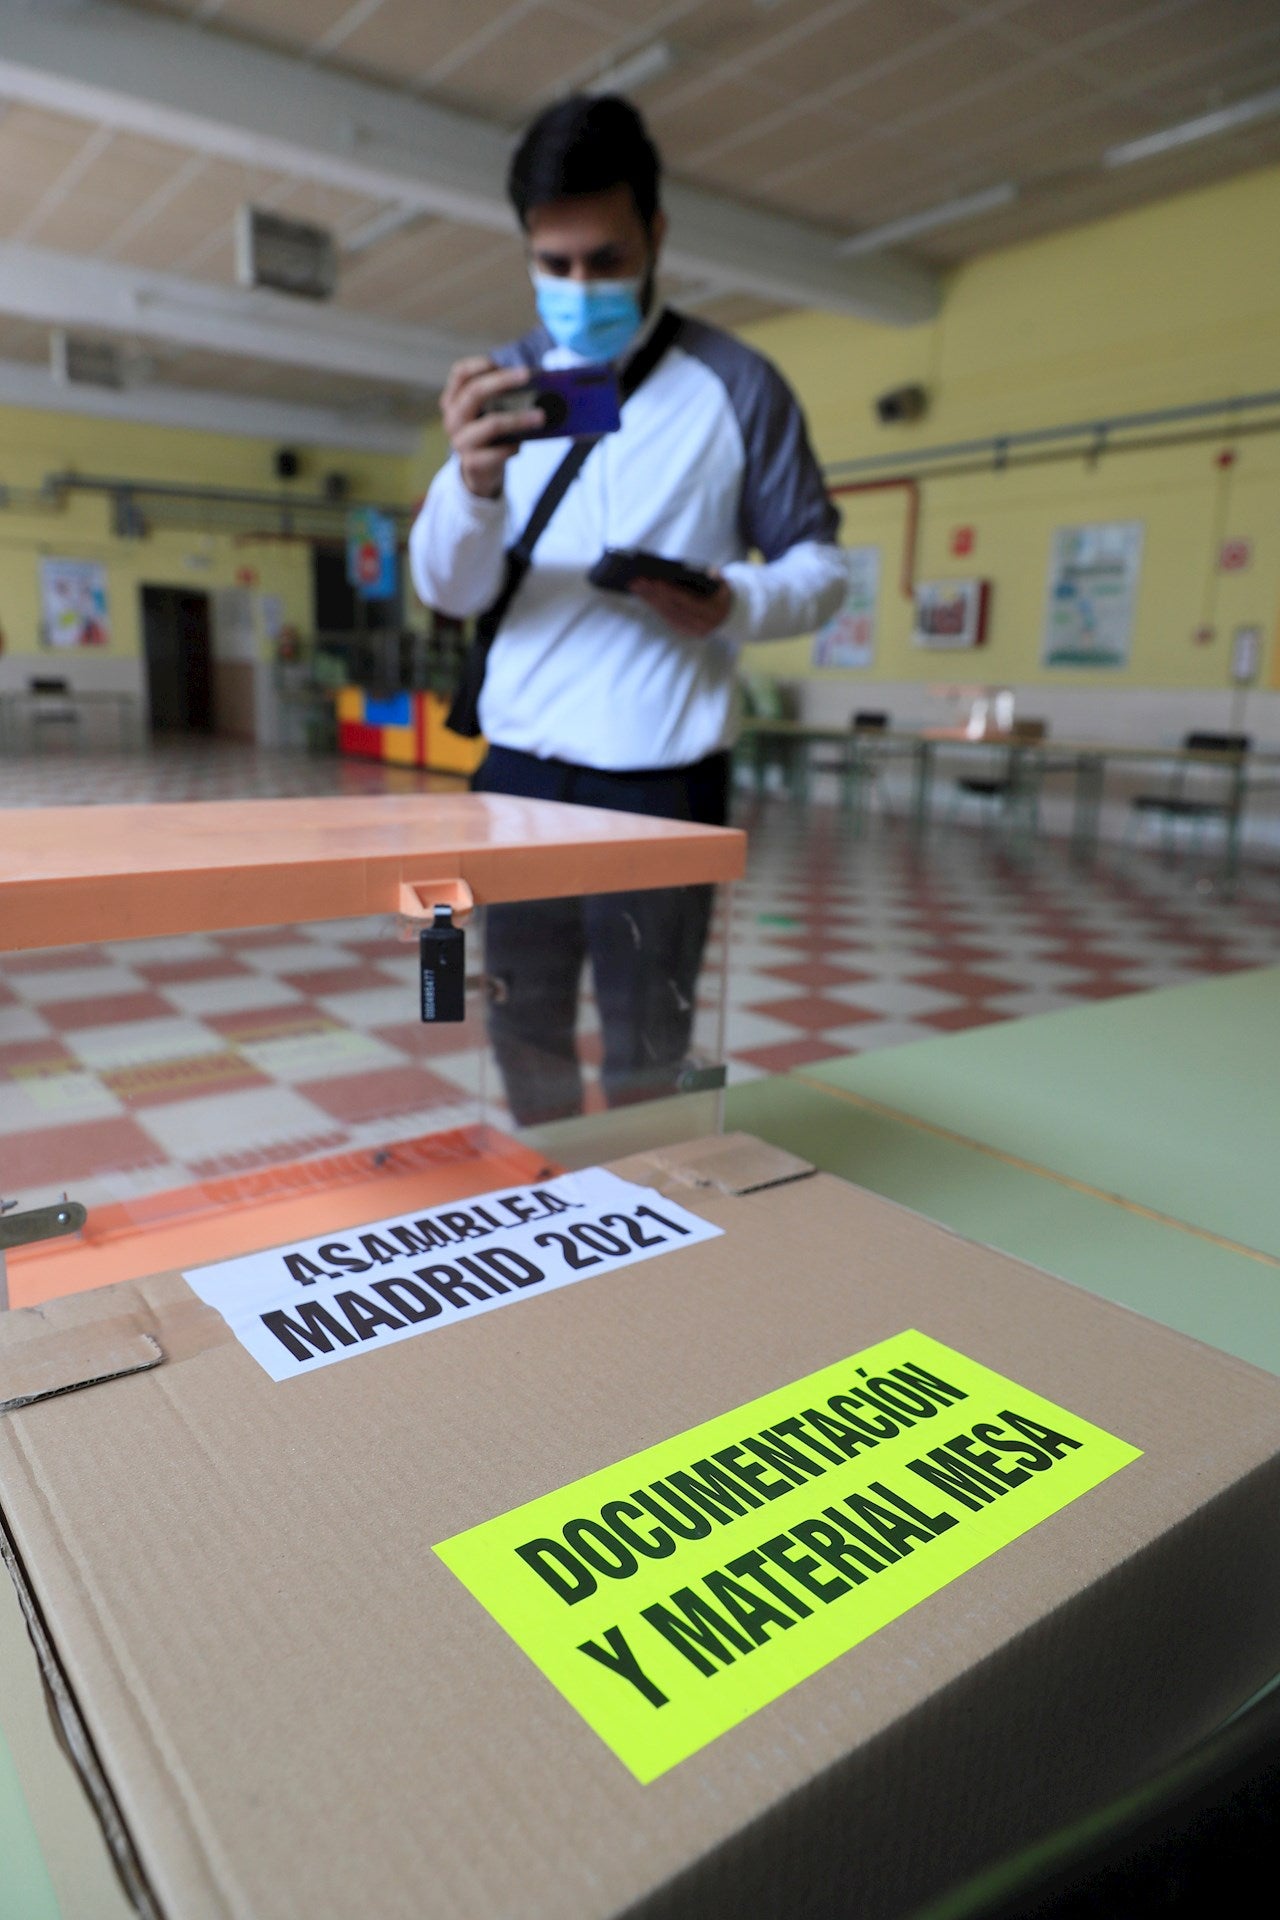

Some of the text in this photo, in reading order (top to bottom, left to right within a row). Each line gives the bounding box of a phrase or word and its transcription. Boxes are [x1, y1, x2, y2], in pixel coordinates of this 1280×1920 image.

[259, 1205, 691, 1362] MADRID 2021
[514, 1362, 969, 1606] DOCUMENTACIÓN
[577, 1410, 1084, 1709] Y MATERIAL MESA
